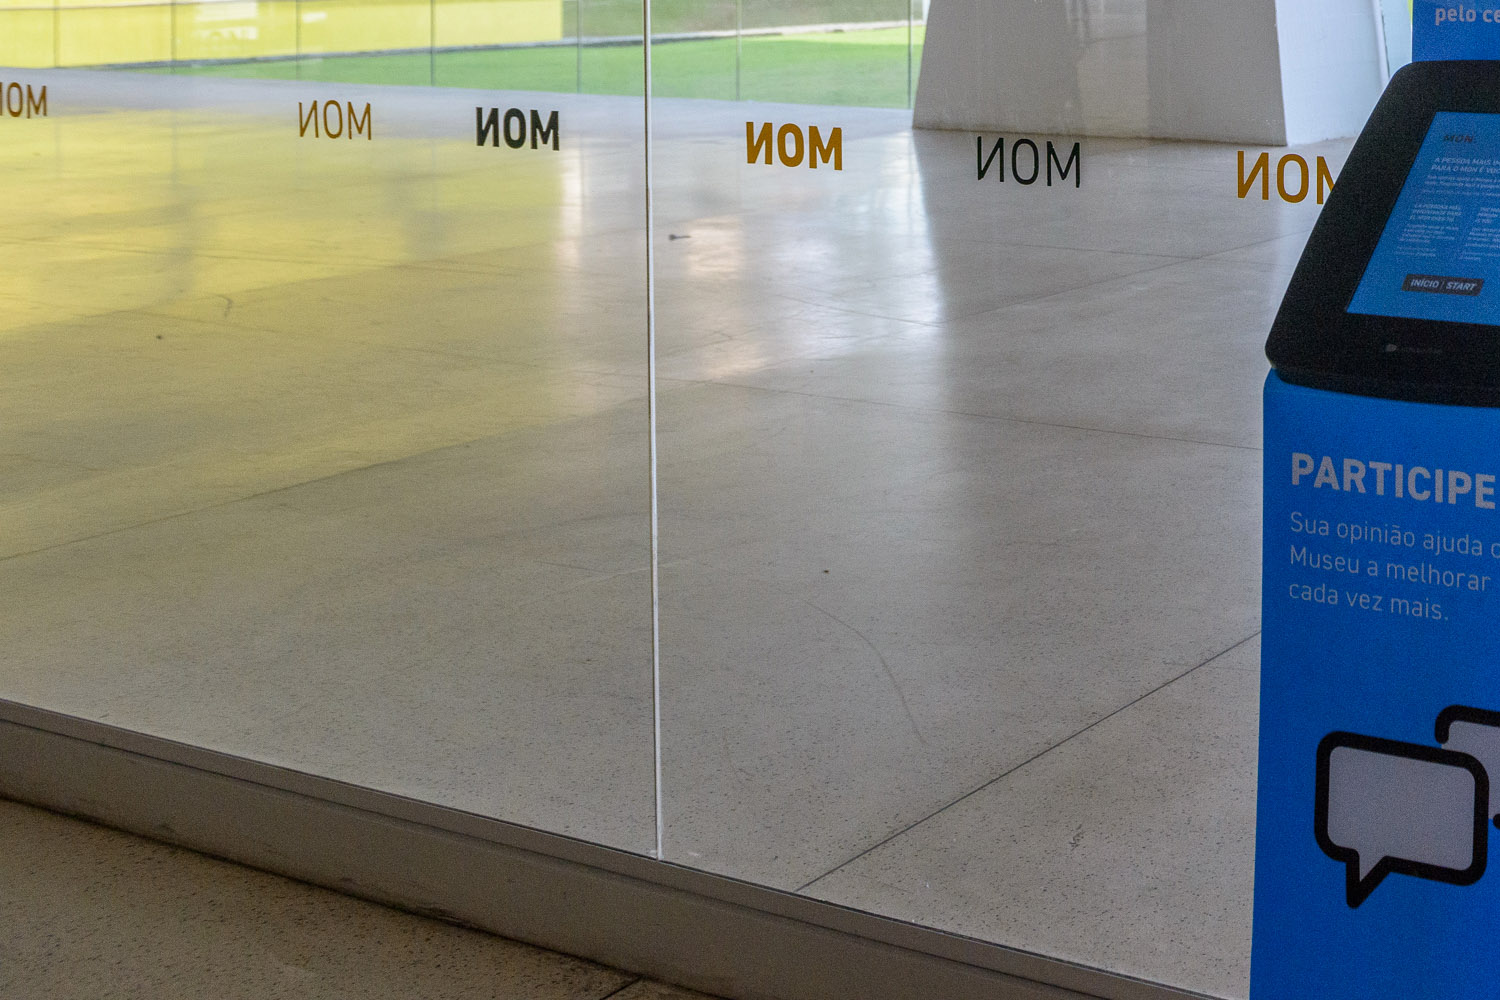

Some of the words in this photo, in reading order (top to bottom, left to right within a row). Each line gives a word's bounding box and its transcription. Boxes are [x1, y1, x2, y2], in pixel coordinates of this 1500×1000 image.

[1435, 5, 1477, 26] pelo
[1411, 278, 1439, 289] INÍCIO
[1446, 281, 1477, 291] START
[1292, 452, 1496, 510] PARTICIPE
[1290, 511, 1329, 536] Sua
[1337, 520, 1415, 547] opinião
[1423, 531, 1483, 556] ajuda
[1290, 545, 1359, 574] Museu
[1367, 560, 1378, 577] a
[1387, 561, 1491, 591] melhorar
[1289, 583, 1338, 605] cada
[1346, 591, 1383, 612] vez
[1391, 597, 1449, 621] mais.
